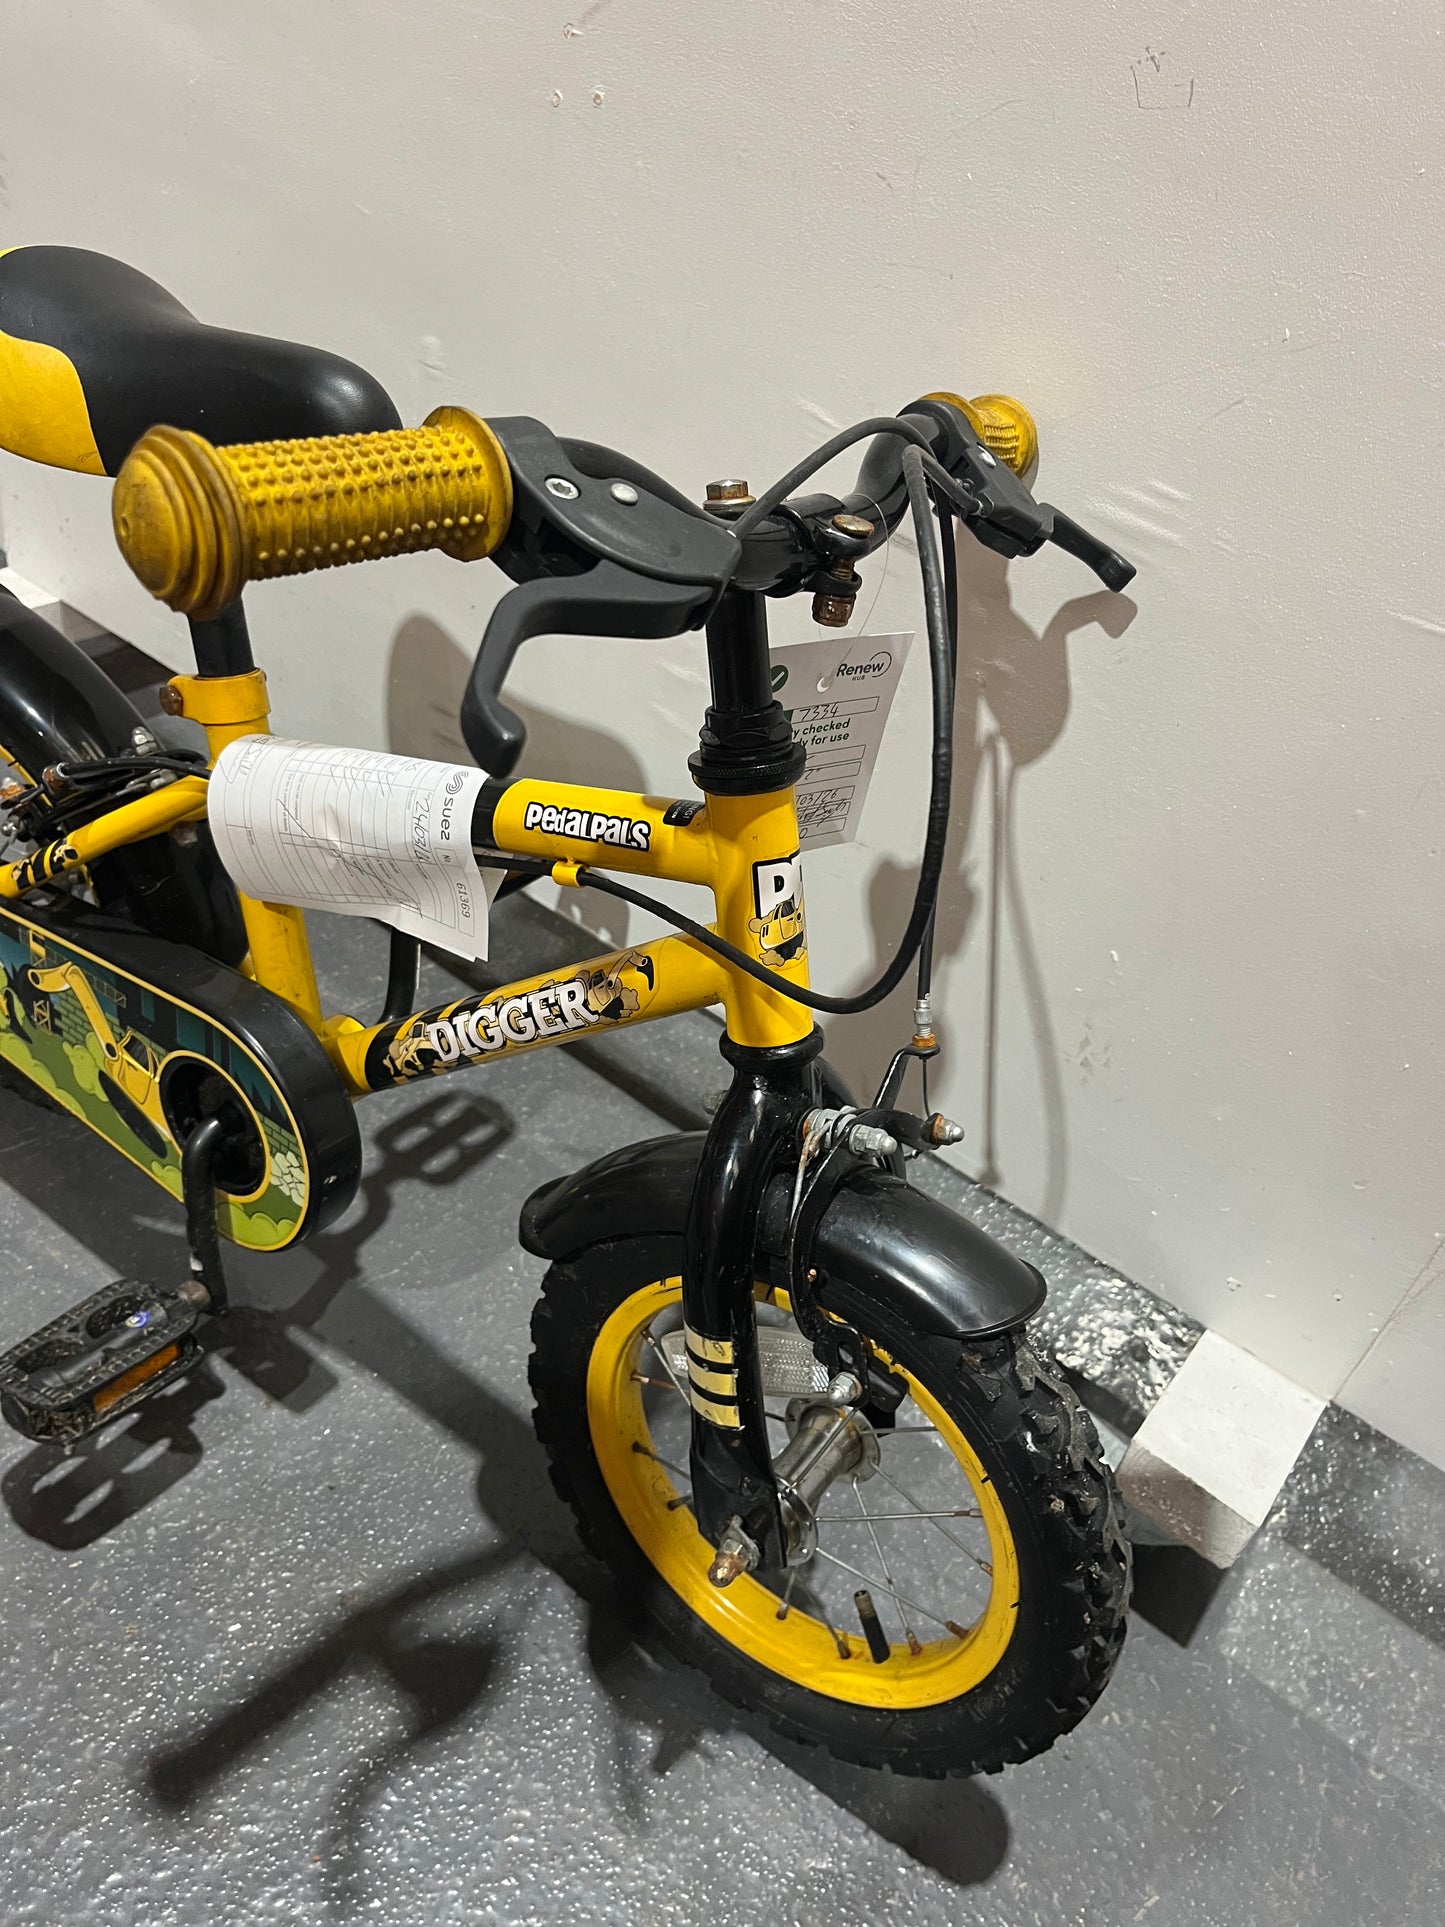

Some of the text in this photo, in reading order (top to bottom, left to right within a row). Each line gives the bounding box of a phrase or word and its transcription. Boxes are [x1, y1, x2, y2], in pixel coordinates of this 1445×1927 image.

[836, 662, 885, 678] Renew
[799, 701, 840, 723] 7334
[802, 717, 851, 736] checked
[810, 734, 829, 746] for
[829, 732, 850, 743] use
[440, 796, 454, 841] suez
[456, 882, 471, 919] 61369
[425, 978, 599, 1062] DIGGER
